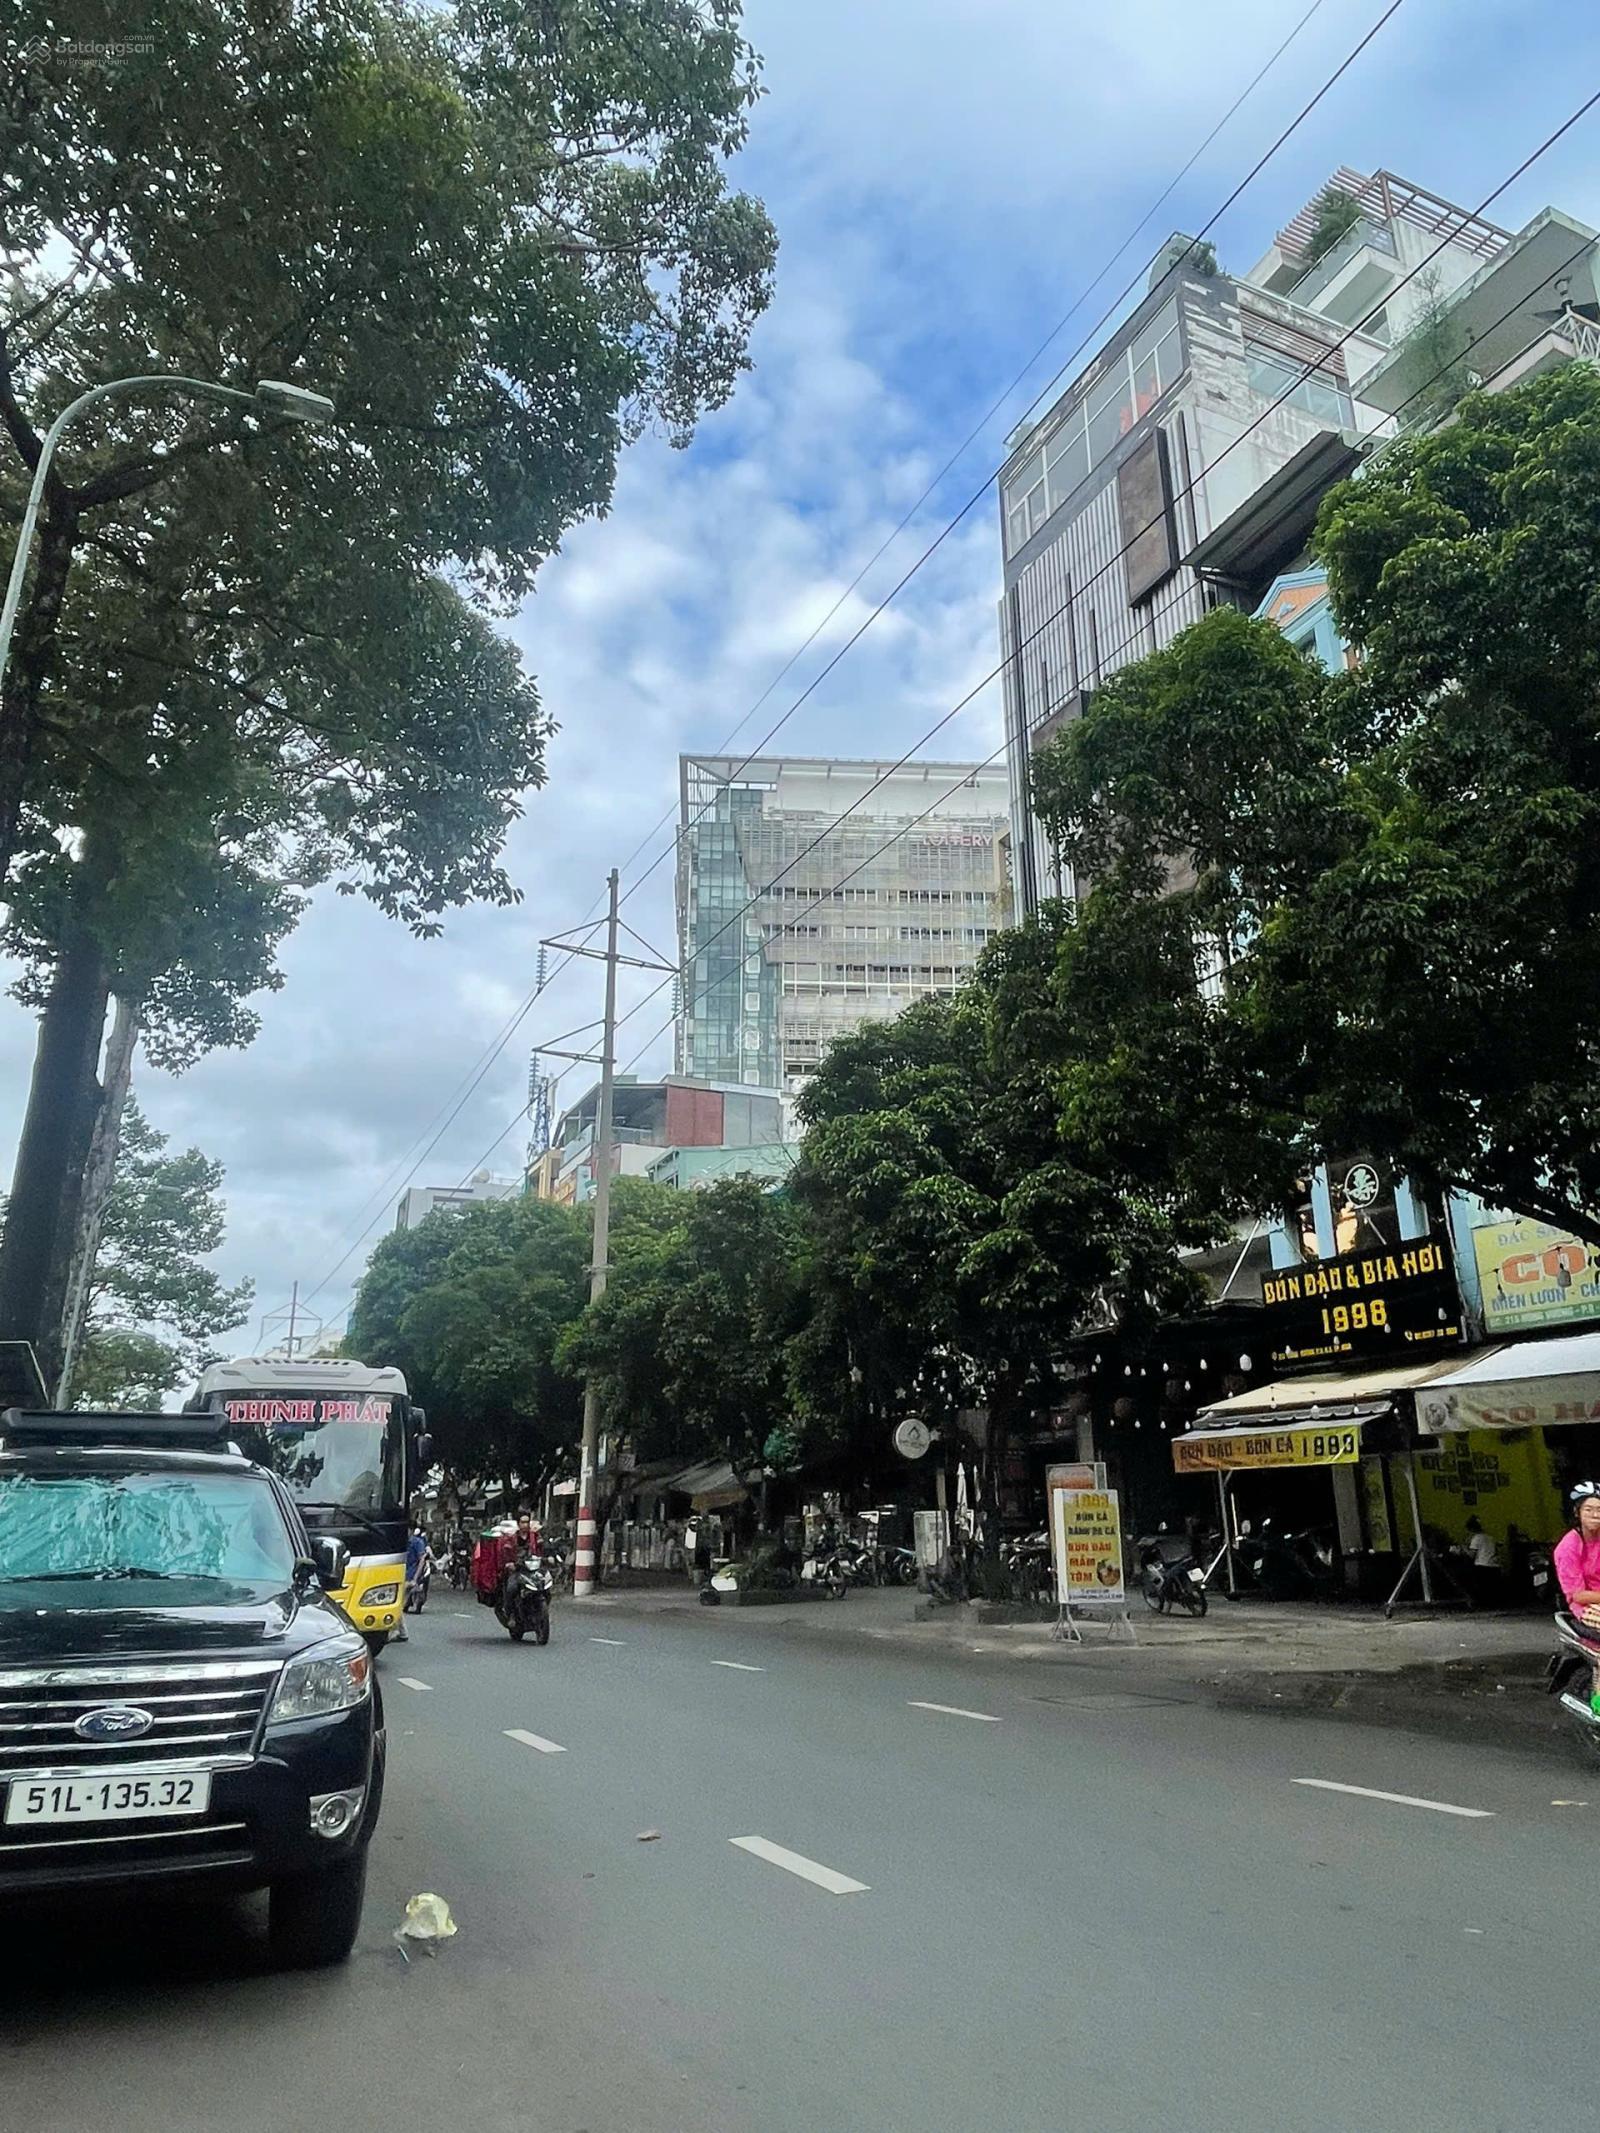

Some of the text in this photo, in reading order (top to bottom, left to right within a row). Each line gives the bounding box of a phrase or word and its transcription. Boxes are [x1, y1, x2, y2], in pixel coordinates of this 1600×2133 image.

[1264, 1244, 1444, 1304] BÚN ĐẬU & BIA HƠI
[1321, 1299, 1388, 1335] 1998
[225, 1395, 391, 1427] THỊNH PHÁT
[101, 1713, 134, 1731] Ford
[26, 1779, 194, 1815] 51L-135.32
